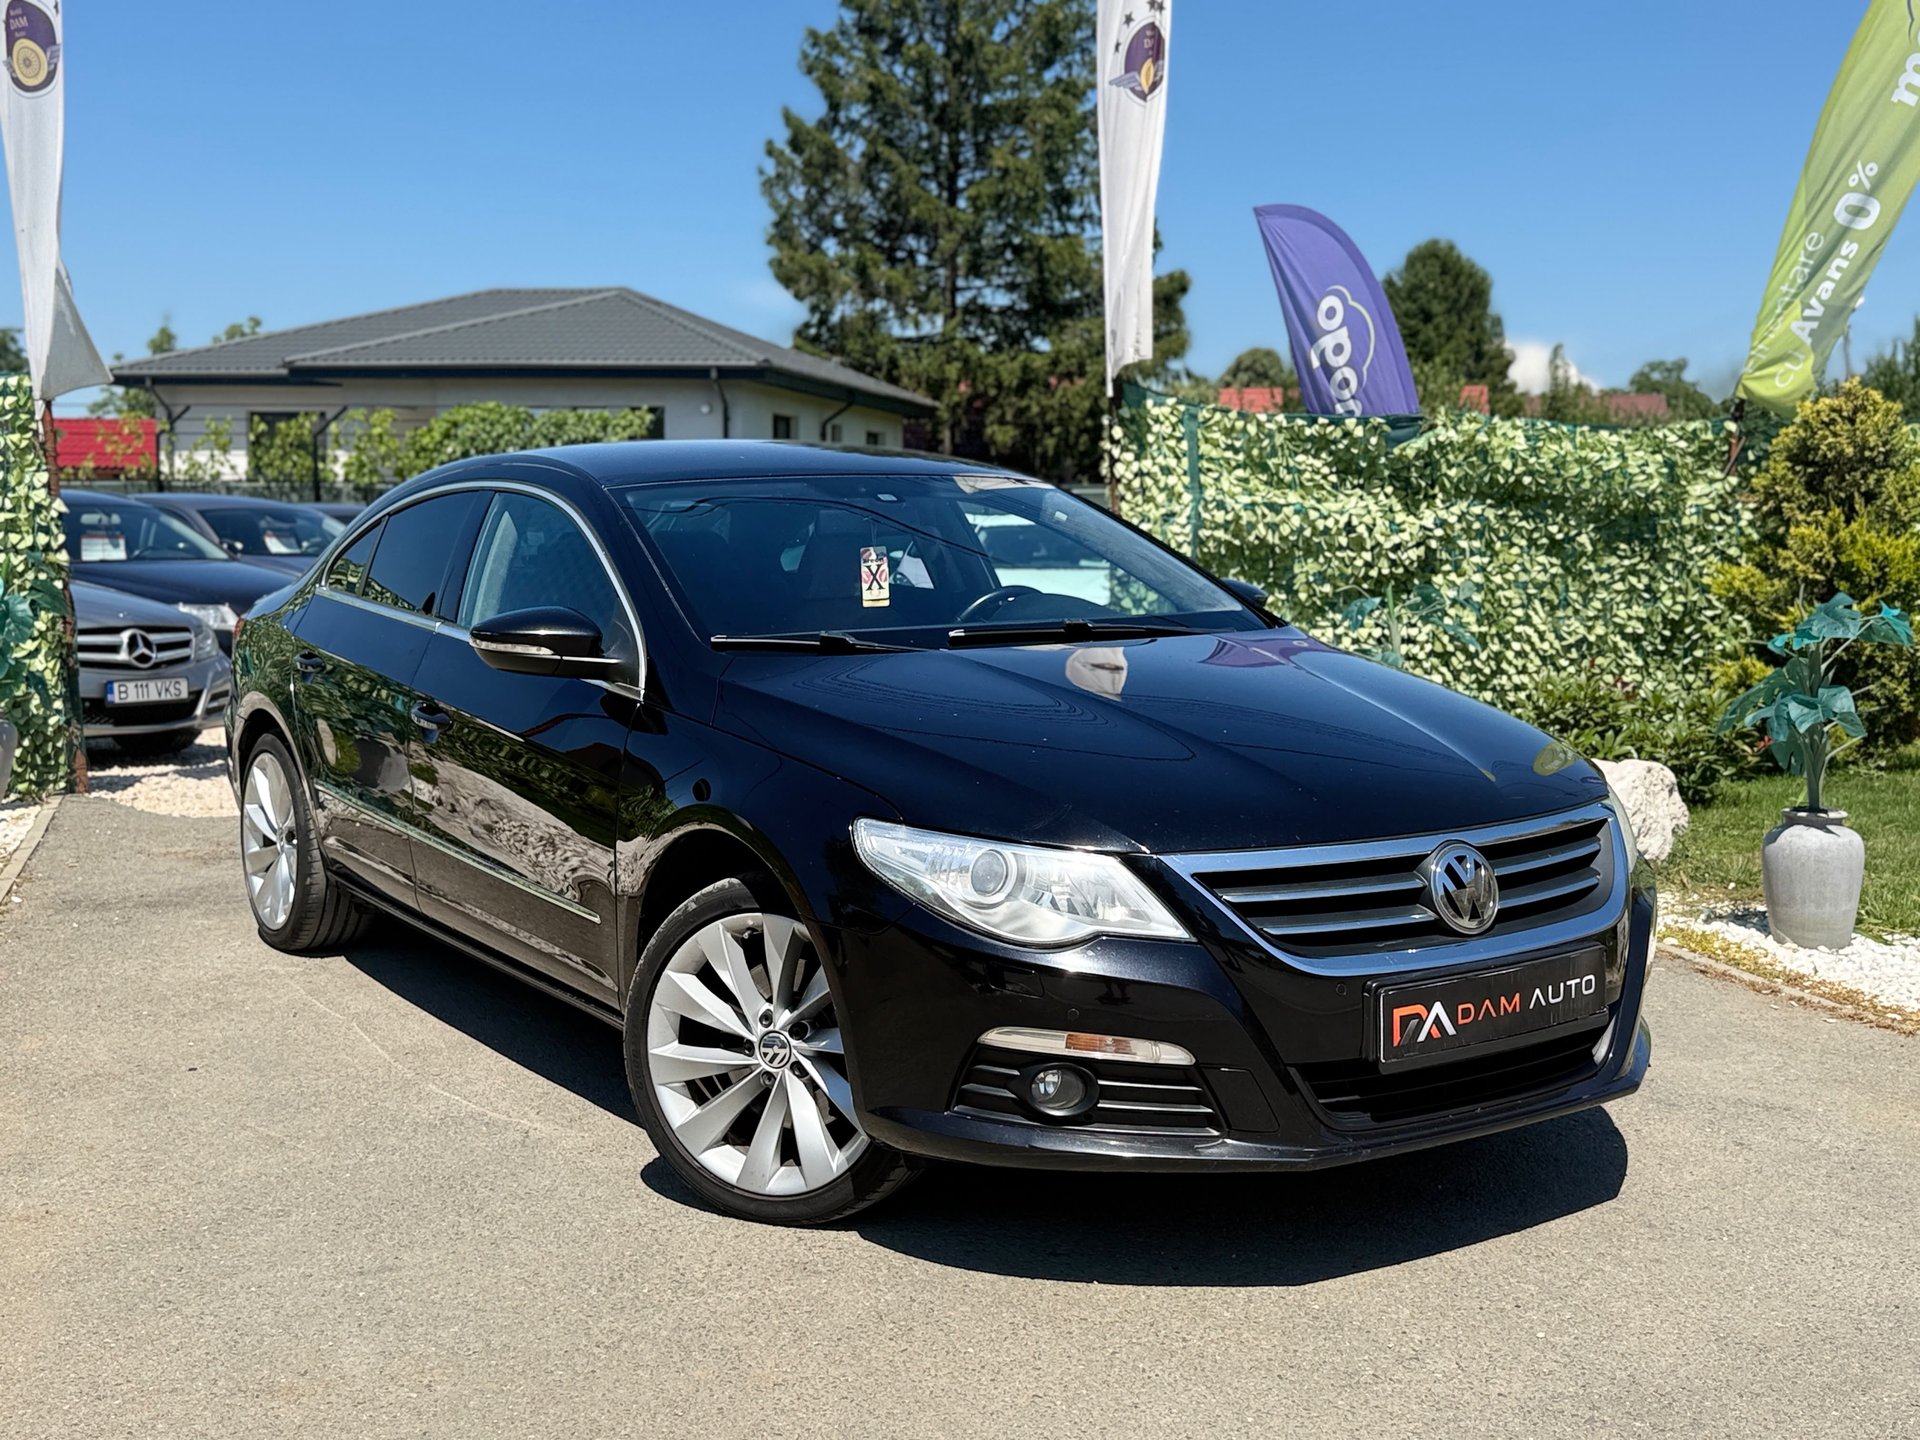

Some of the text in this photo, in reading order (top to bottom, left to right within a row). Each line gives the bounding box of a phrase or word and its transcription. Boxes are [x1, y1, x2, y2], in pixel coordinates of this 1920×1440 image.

[9, 16, 29, 30] DAM
[1775, 350, 1805, 388] cu
[1790, 240, 1859, 347] Avans
[864, 563, 886, 591] X
[118, 680, 182, 700] B 111 VKS
[1457, 992, 1521, 1025] DAM
[1529, 974, 1596, 1009] AUTO
